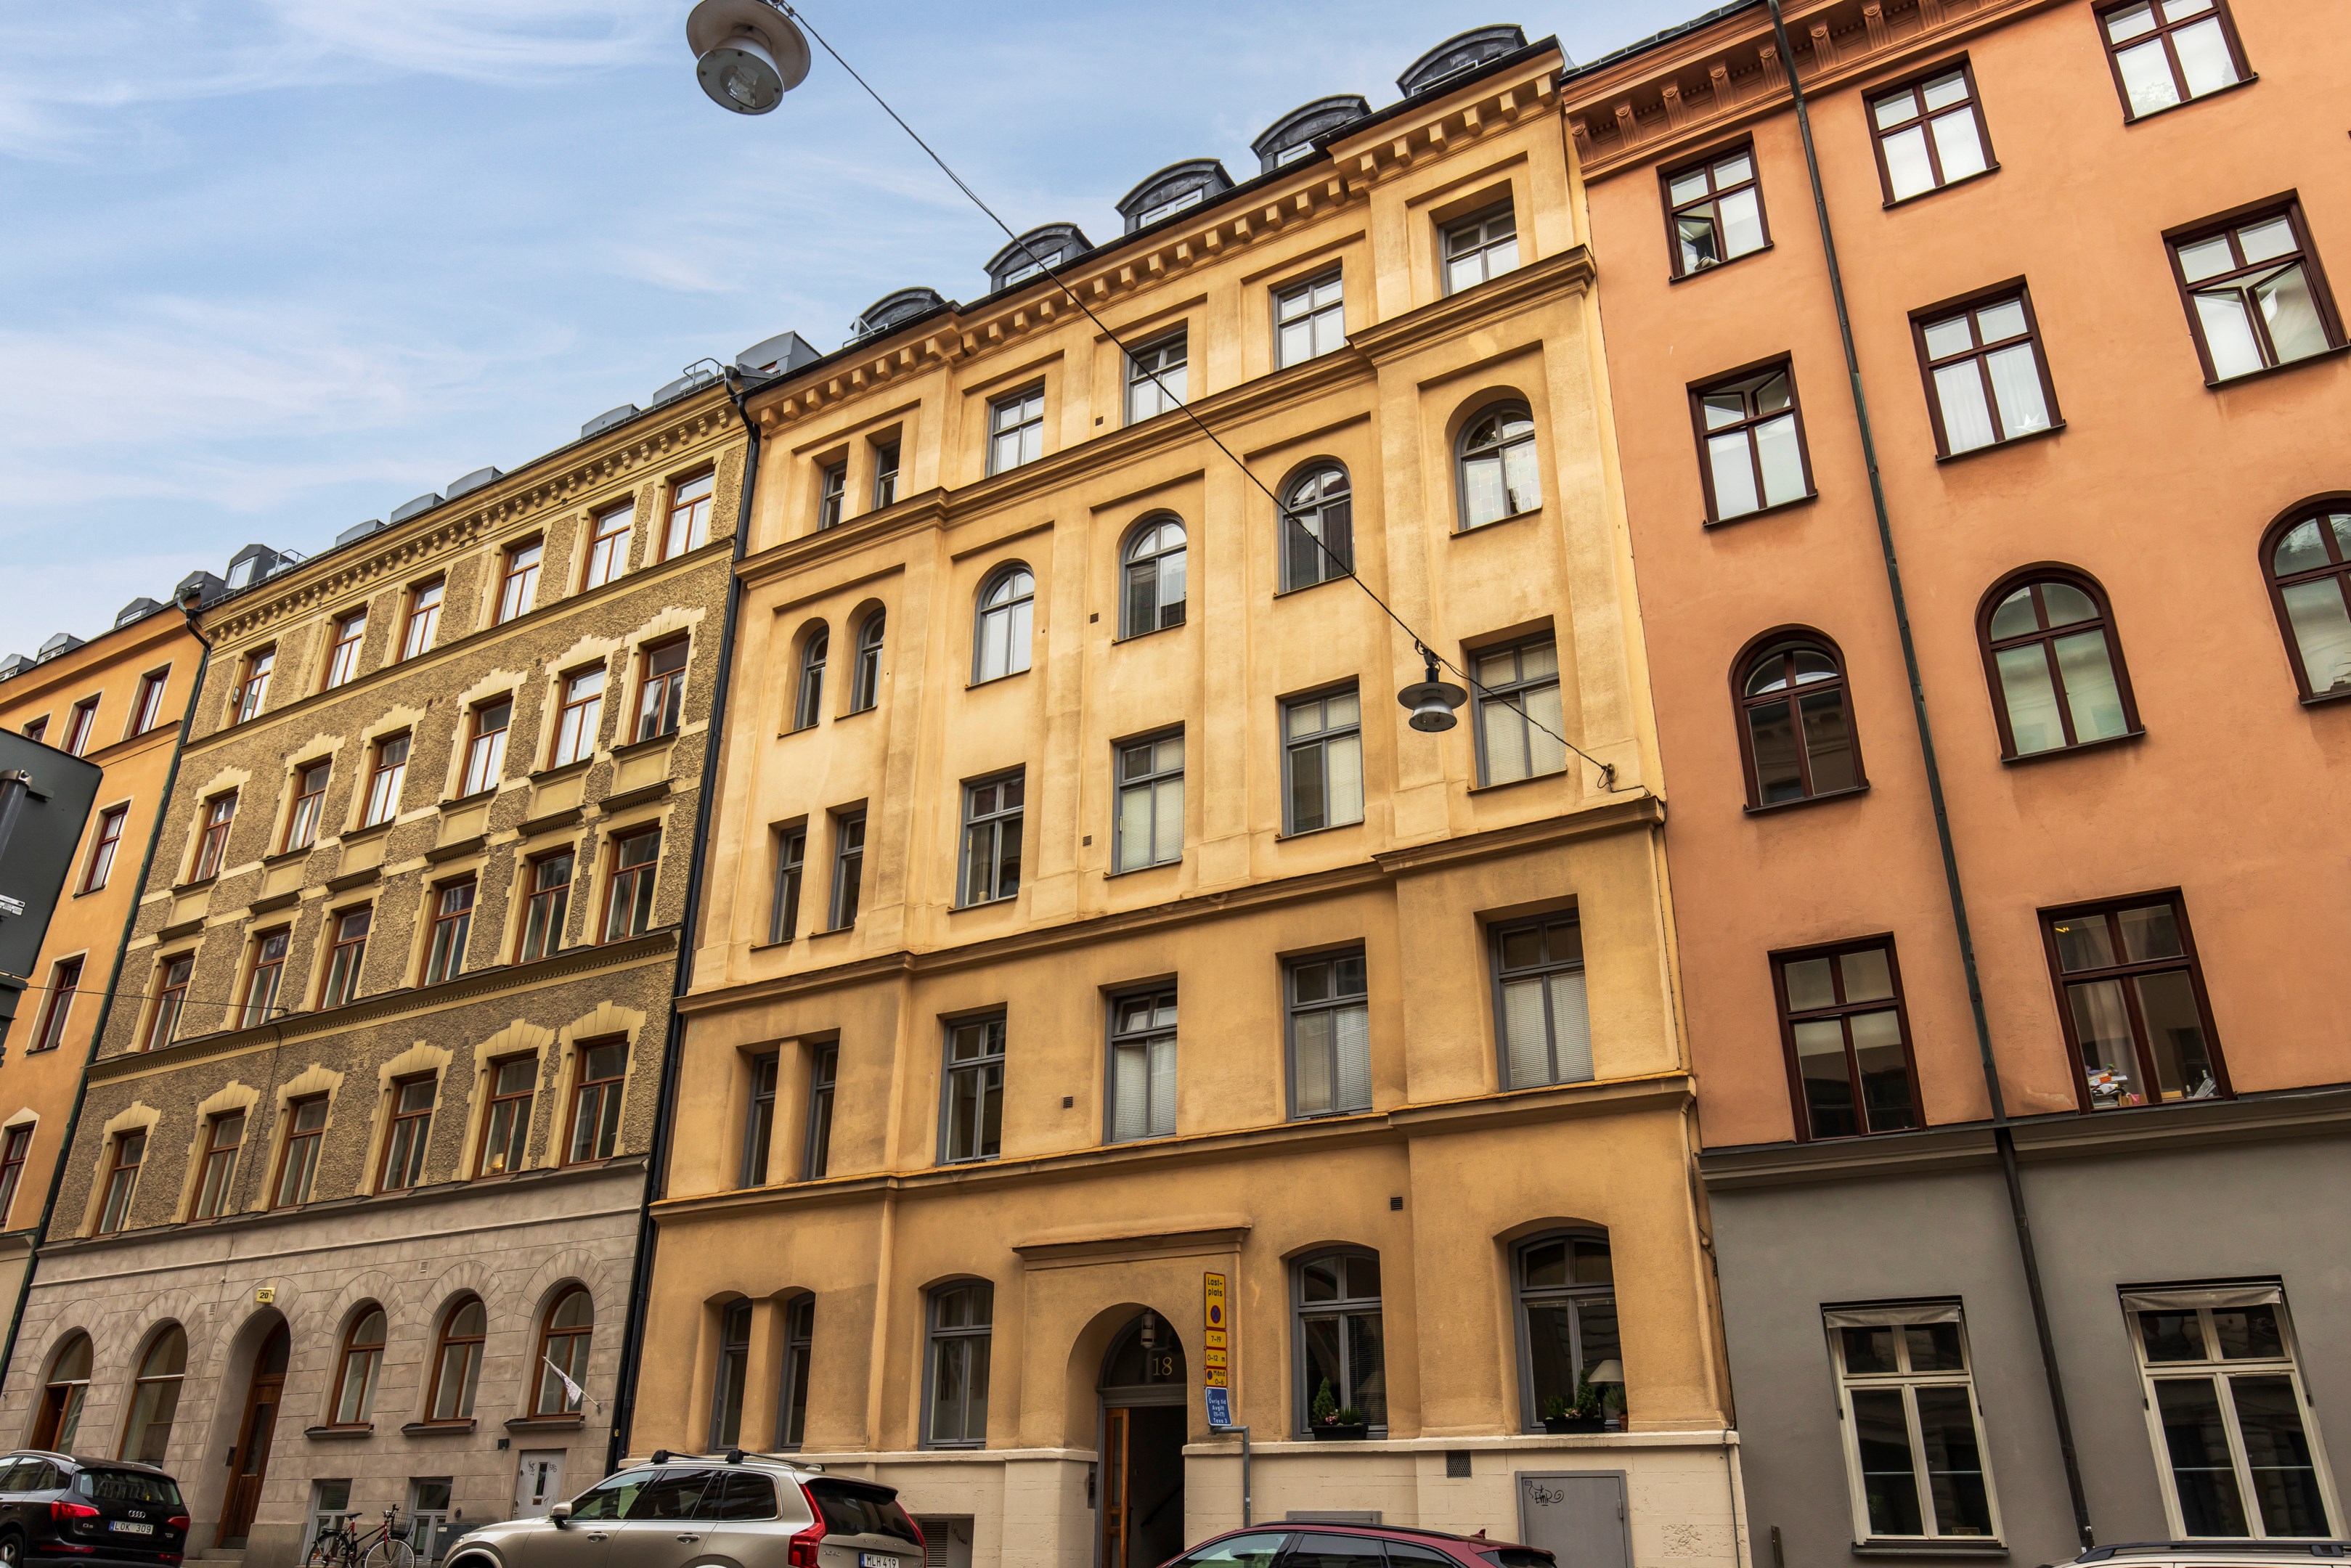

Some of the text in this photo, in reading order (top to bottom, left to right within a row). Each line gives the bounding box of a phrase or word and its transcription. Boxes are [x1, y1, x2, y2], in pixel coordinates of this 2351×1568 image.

[1207, 1276, 1223, 1286] Last-
[1207, 1288, 1223, 1297] plats
[1153, 1357, 1173, 1376] 18
[115, 1522, 151, 1533] LOK 309
[867, 1555, 897, 1568] MLH 419
